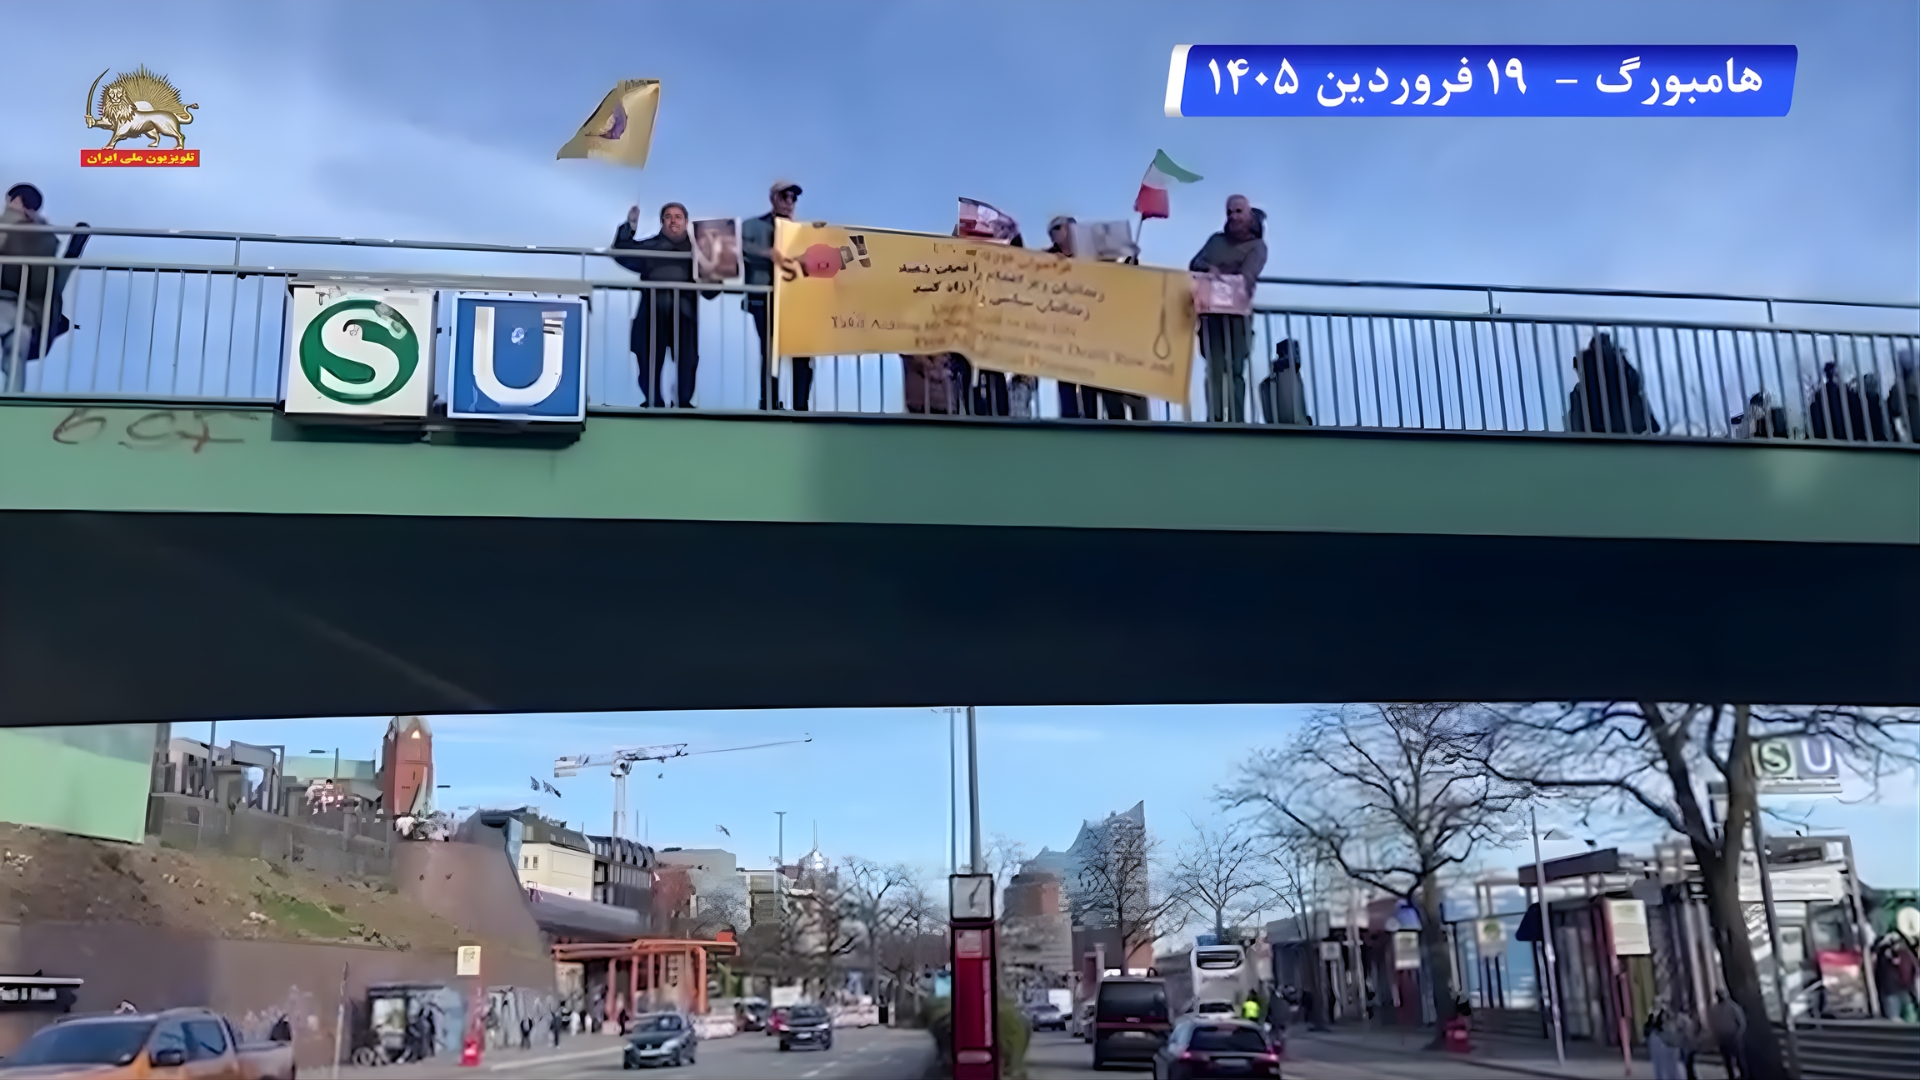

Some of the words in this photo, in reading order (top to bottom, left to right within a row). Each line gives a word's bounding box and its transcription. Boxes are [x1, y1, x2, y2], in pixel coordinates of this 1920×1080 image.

[319, 307, 407, 396] S
[472, 305, 567, 407] U
[1760, 741, 1790, 773] S
[1800, 738, 1832, 773] U
